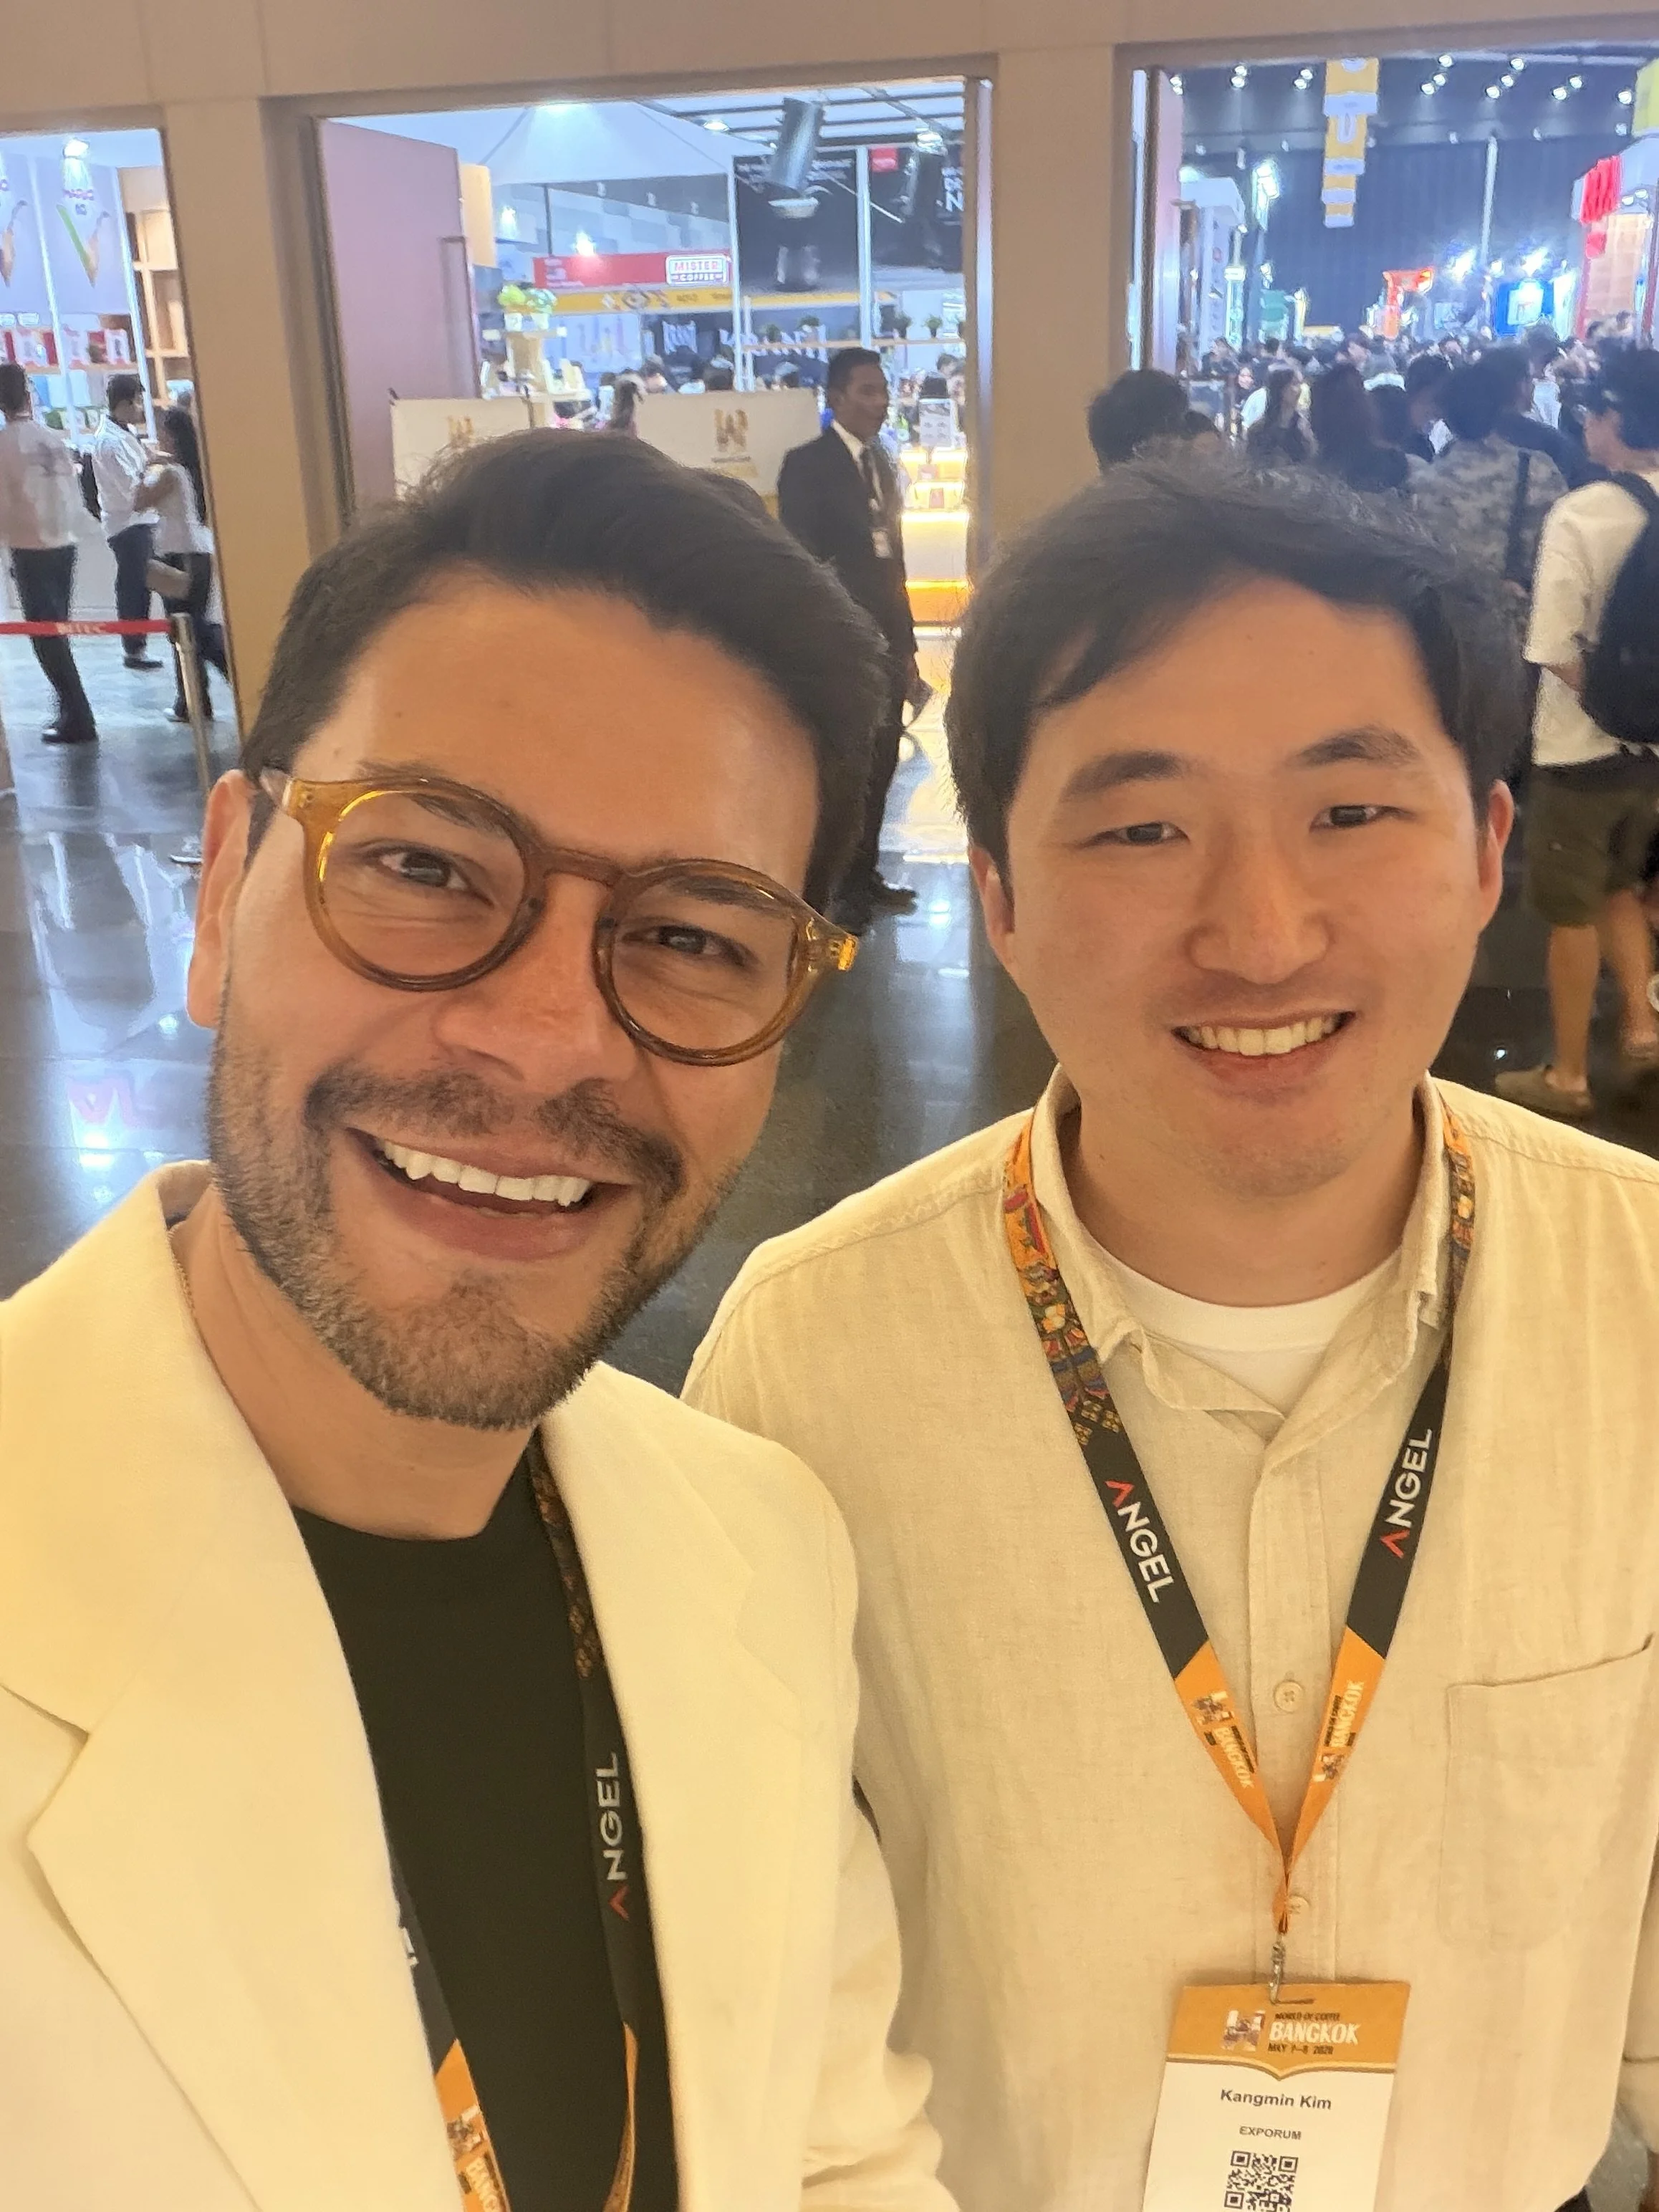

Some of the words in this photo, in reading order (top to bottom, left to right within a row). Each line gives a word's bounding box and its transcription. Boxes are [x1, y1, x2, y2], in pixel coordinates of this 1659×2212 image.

[675, 261, 718, 271] MISTER
[1380, 1428, 1433, 1558] ANGEL
[1105, 1479, 1175, 1603] ANGEL
[1329, 1679, 1365, 1748] BANGKOK
[1213, 1726, 1255, 1789] BANGKOK
[595, 1751, 630, 1922] ANGEL
[1269, 2021, 1361, 2045] BANGKOK
[1220, 2089, 1294, 2107] Kangmin
[1299, 2095, 1332, 2110] Kim
[1239, 2125, 1302, 2140] EXPORUM
